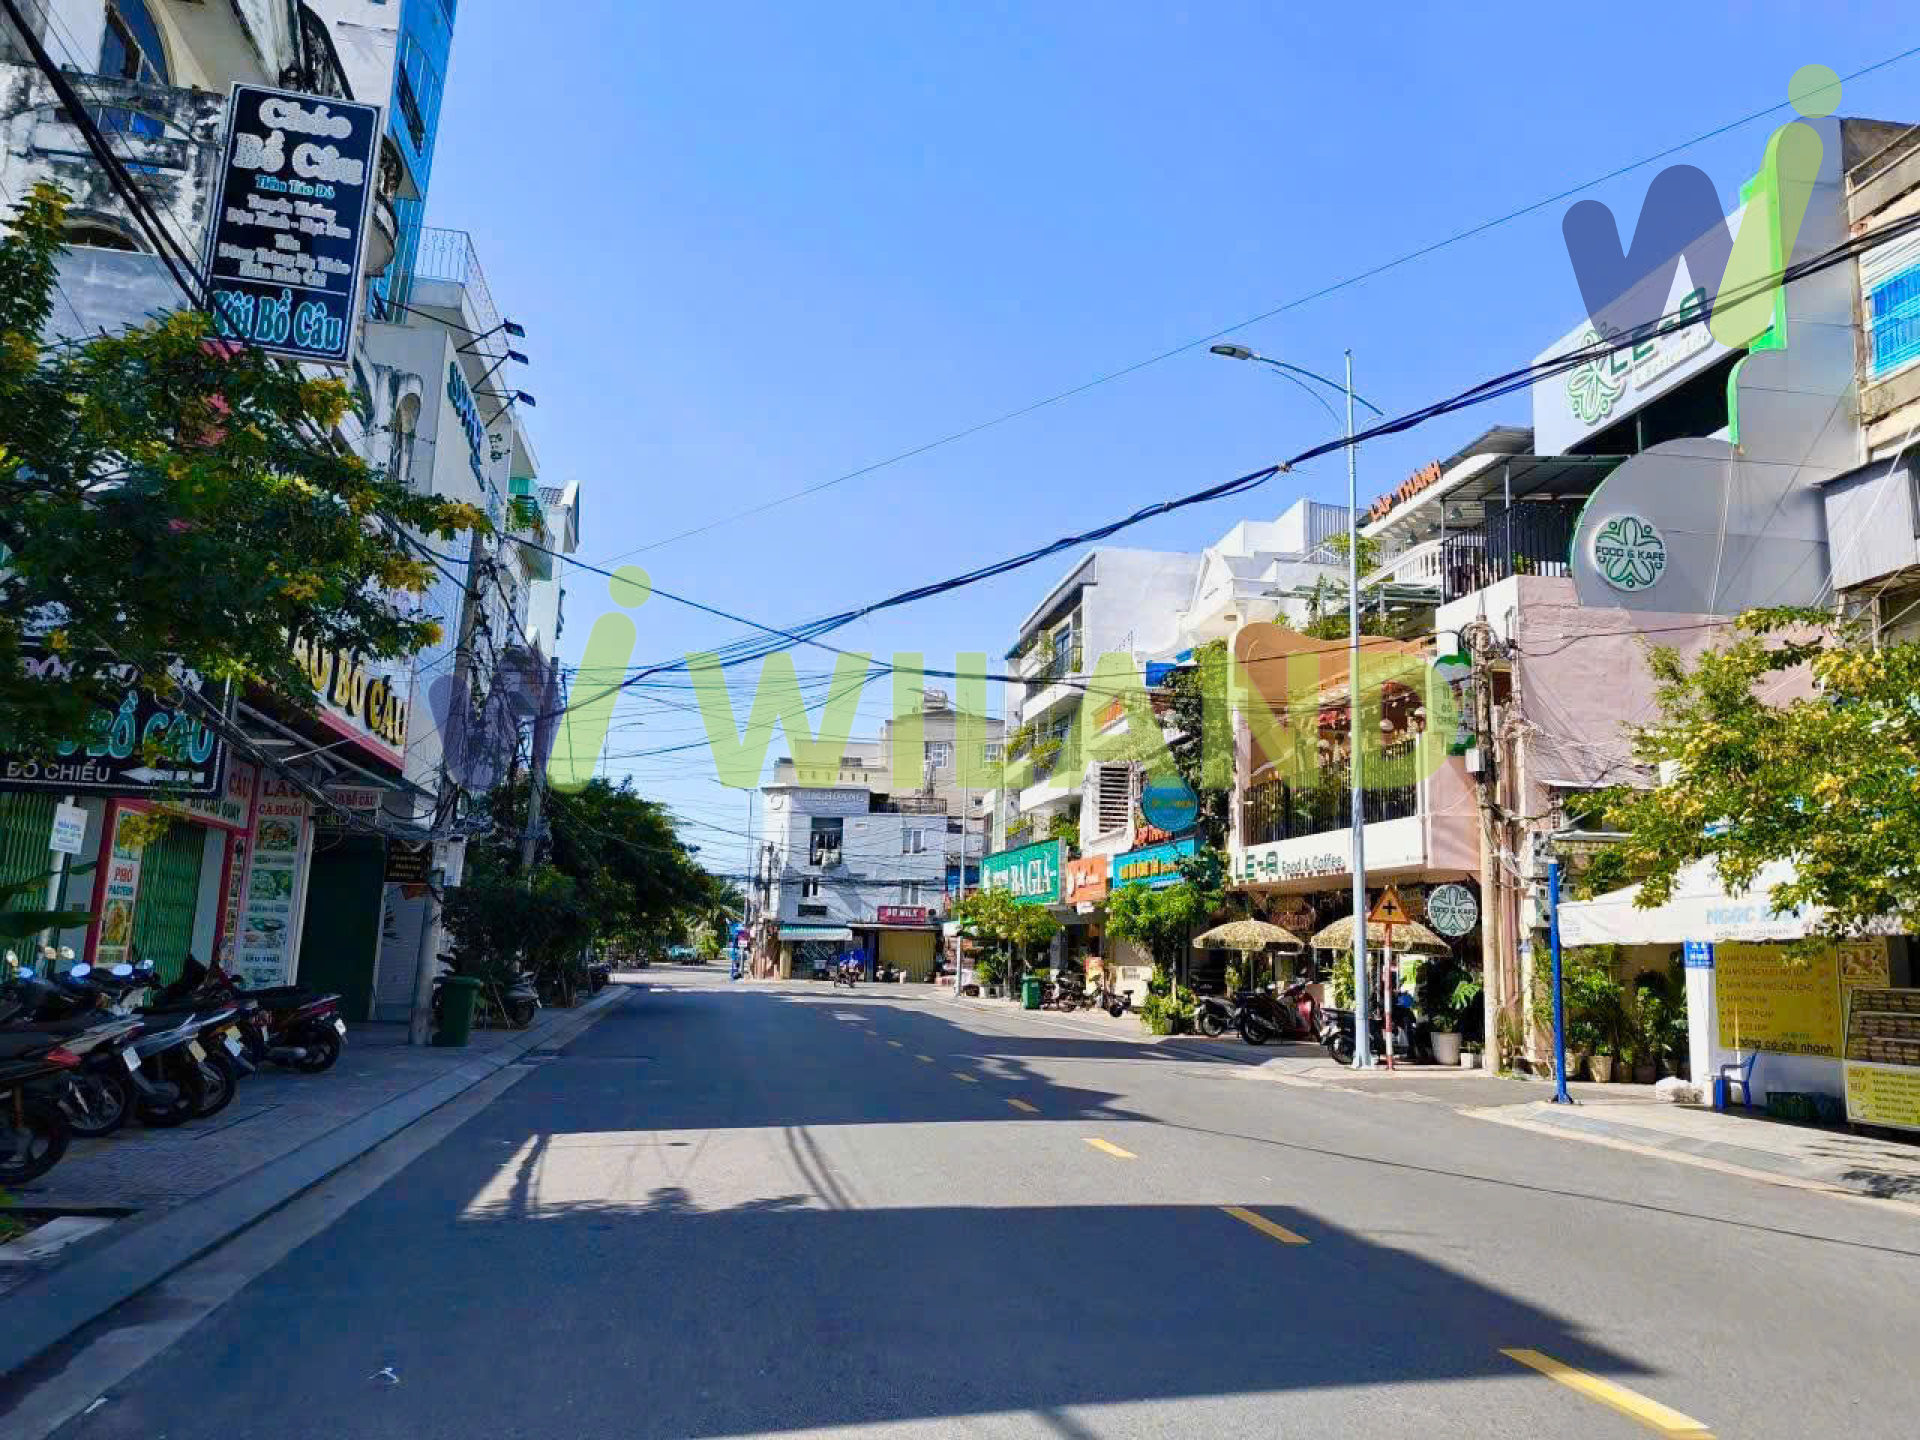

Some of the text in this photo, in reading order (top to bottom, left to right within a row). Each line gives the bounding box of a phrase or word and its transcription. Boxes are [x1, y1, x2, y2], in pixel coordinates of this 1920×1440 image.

[1595, 546, 1624, 557] FOOD
[1637, 550, 1665, 562] KAFE
[1281, 860, 1301, 874] Food
[1312, 853, 1343, 871] Coffee
